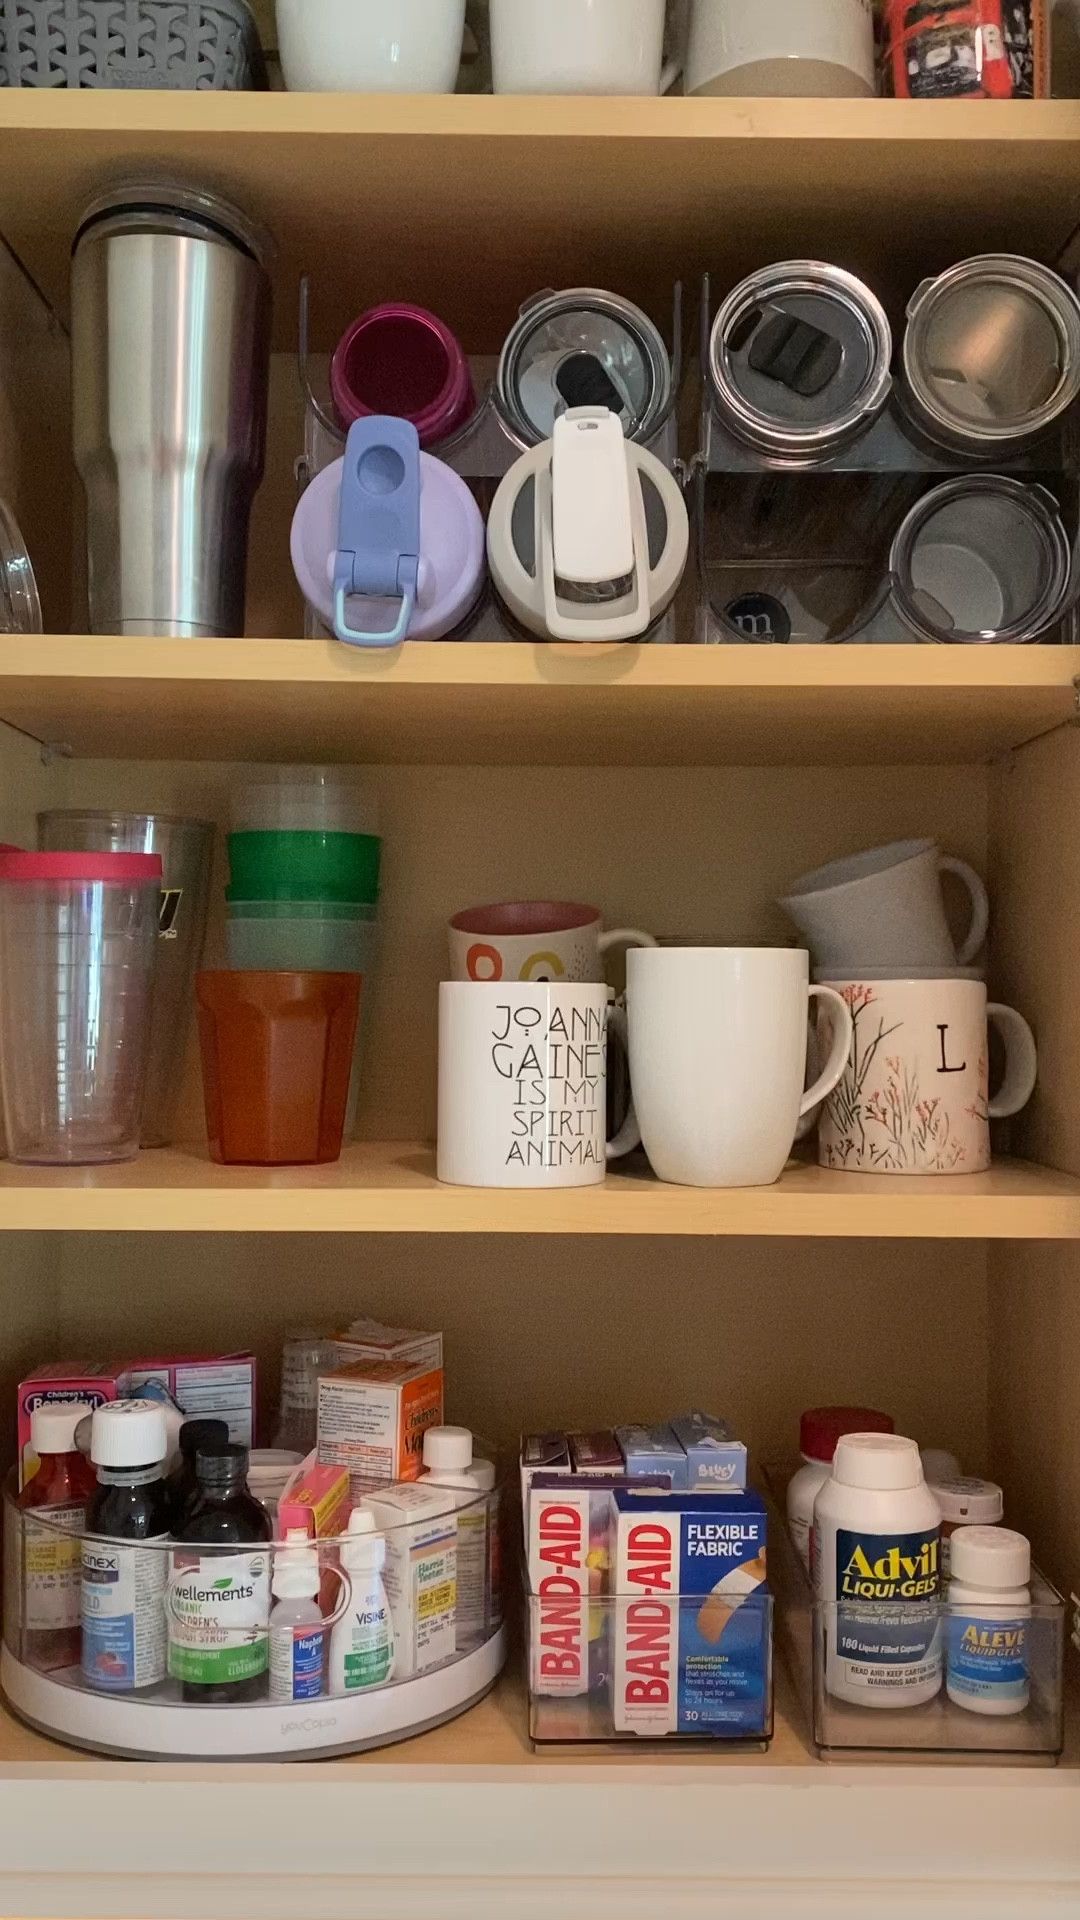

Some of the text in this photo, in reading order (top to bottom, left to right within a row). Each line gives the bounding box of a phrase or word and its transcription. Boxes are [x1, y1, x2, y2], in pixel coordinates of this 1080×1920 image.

[936, 1024, 966, 1073] L
[513, 1079, 598, 1105] IS MY
[511, 1110, 597, 1136] SPIRIT
[505, 1140, 604, 1166] ANIMAL
[688, 1524, 758, 1541] FLEXIBLE
[688, 1541, 743, 1557] FABRIC
[841, 1538, 939, 1580] Advil
[174, 1585, 253, 1602] wellements
[539, 1505, 581, 1677] BAND-AID
[356, 1608, 385, 1625] VISINE
[625, 1523, 671, 1704] BAND-AID
[962, 1625, 1025, 1648] ALEVE
[960, 1643, 996, 1656] LIQUID
[685, 1663, 722, 1671] protection
[851, 1666, 869, 1676] READ
[684, 1710, 699, 1721] 30
